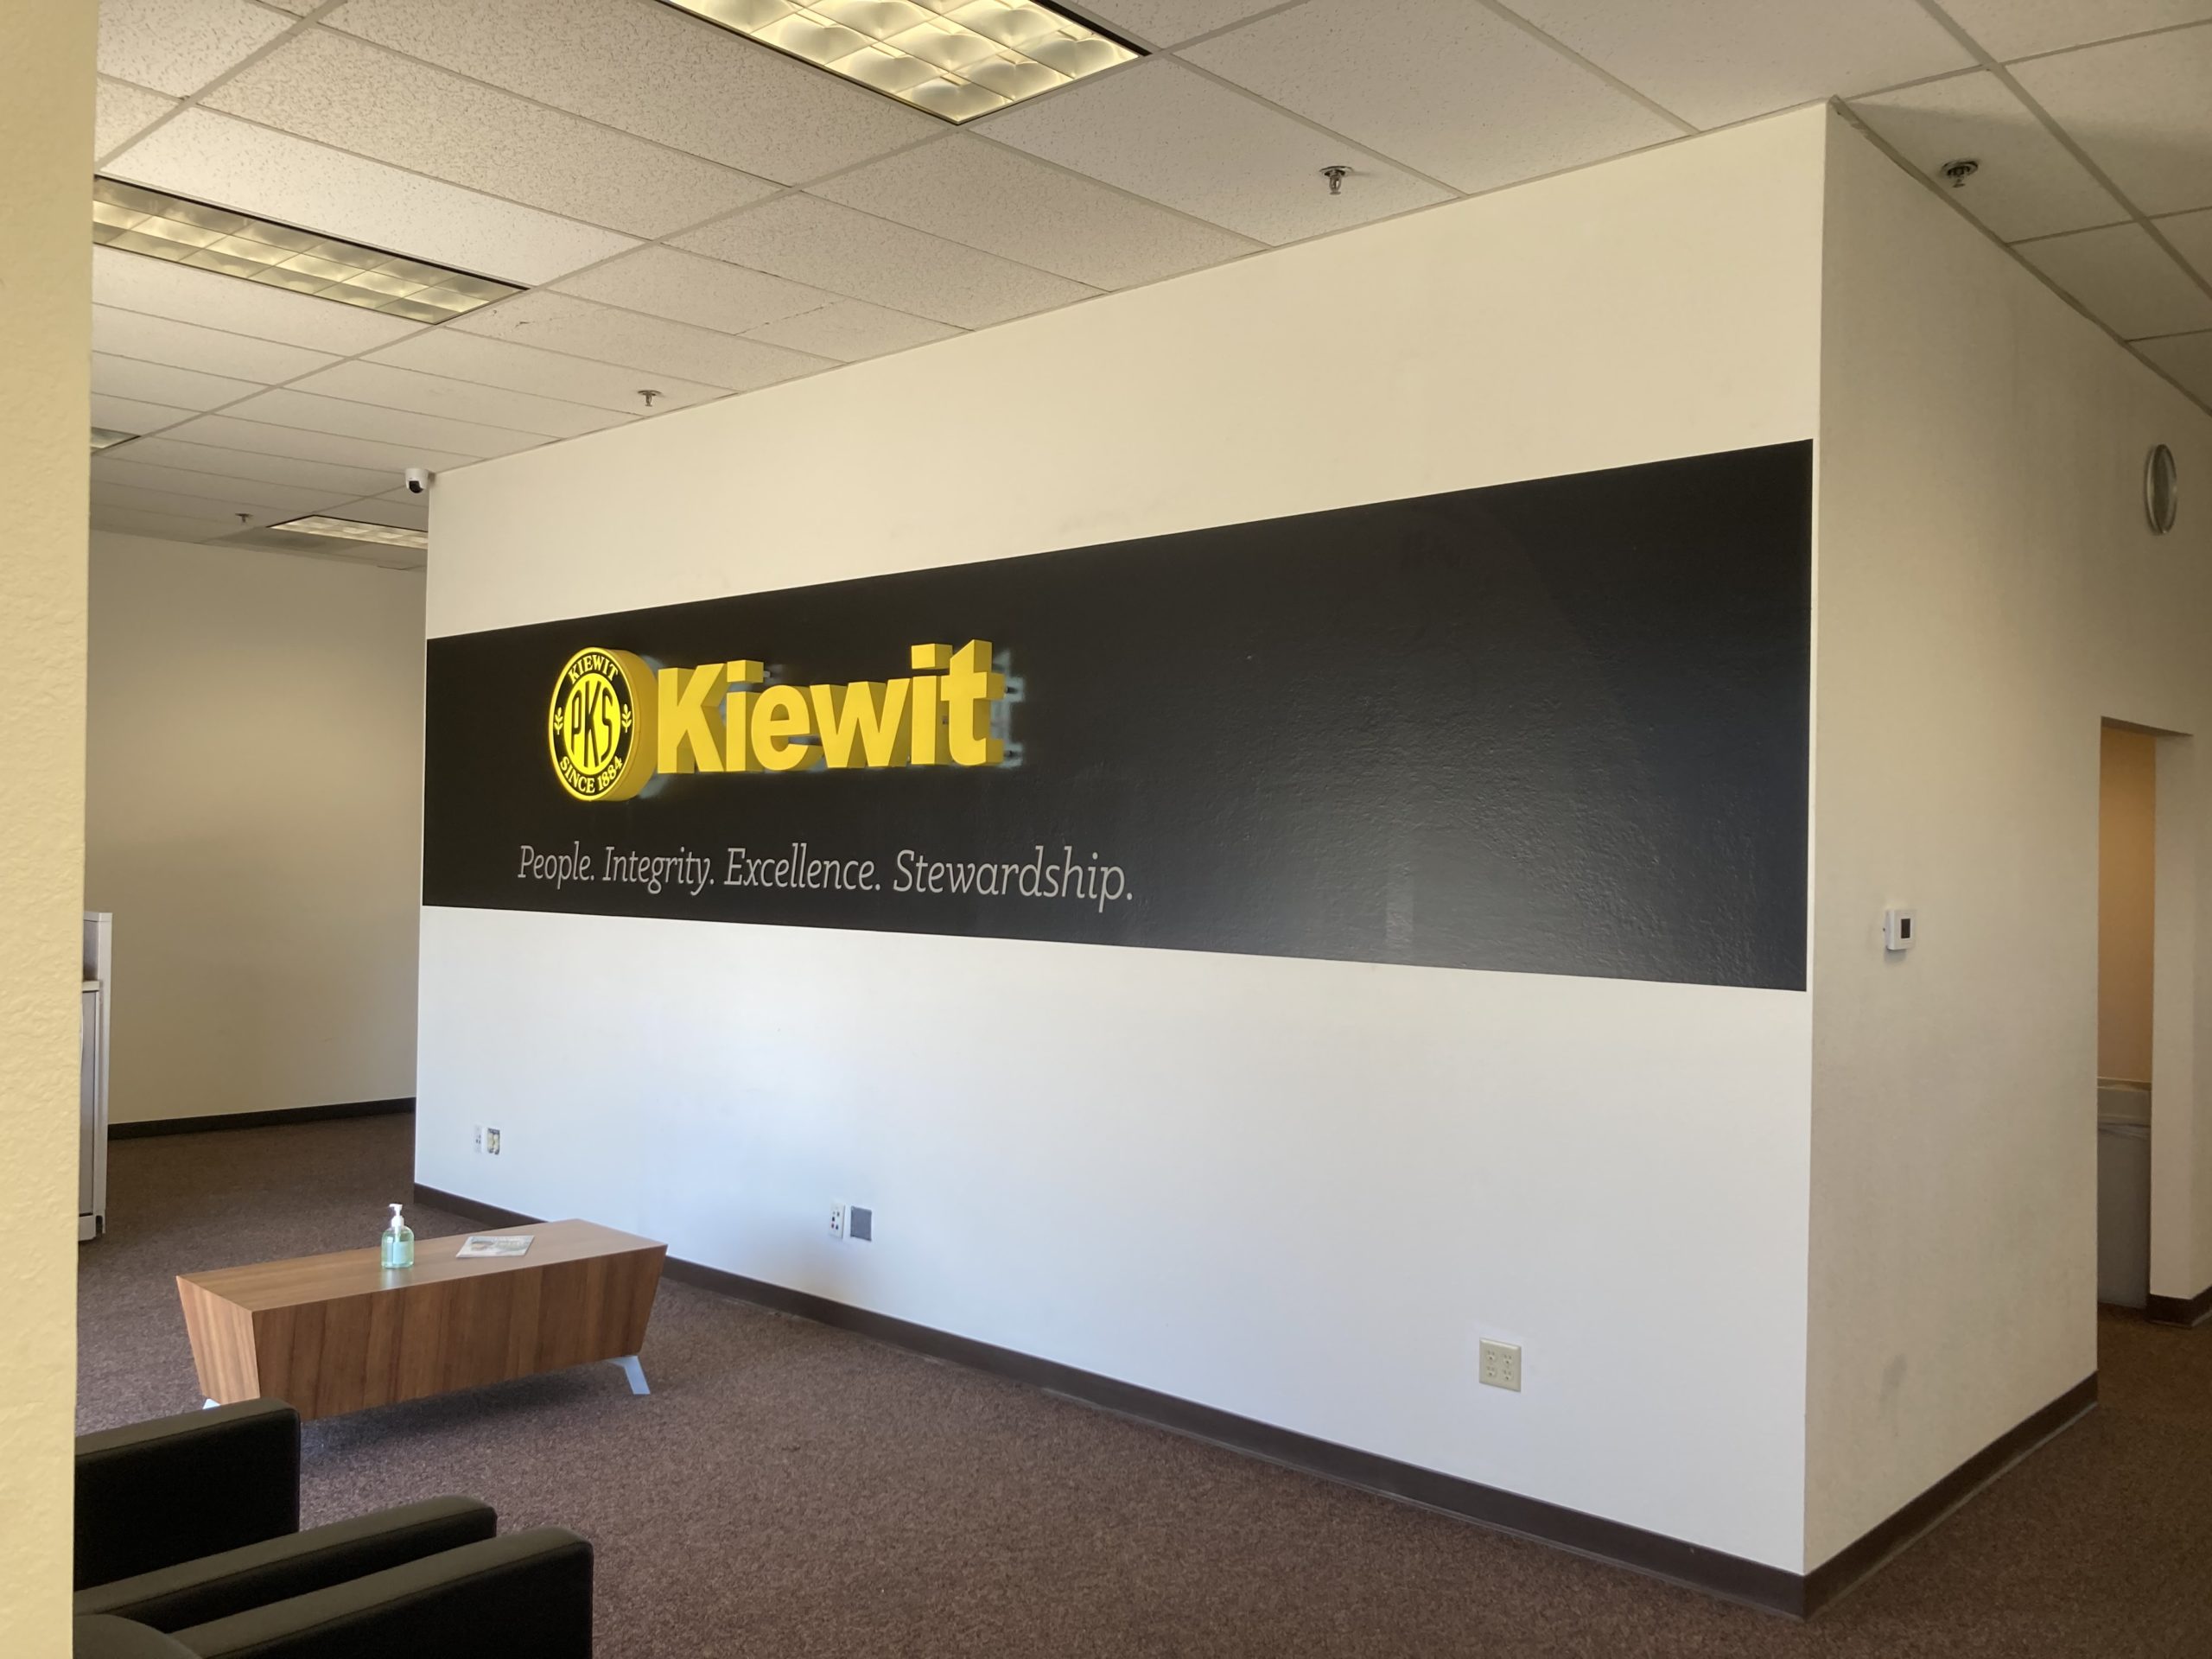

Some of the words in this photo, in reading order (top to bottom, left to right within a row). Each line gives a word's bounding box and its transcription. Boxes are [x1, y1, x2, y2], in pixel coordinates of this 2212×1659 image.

[568, 654, 619, 684] KIEWIT
[570, 679, 613, 768] PKS
[658, 639, 1003, 773] Kiewit
[560, 755, 596, 794] SINCE
[597, 755, 623, 791] 1884
[517, 840, 596, 890] People.
[602, 846, 715, 896] Integrity.
[723, 842, 882, 892] Excellence.
[893, 845, 1134, 913] Stewardship.
